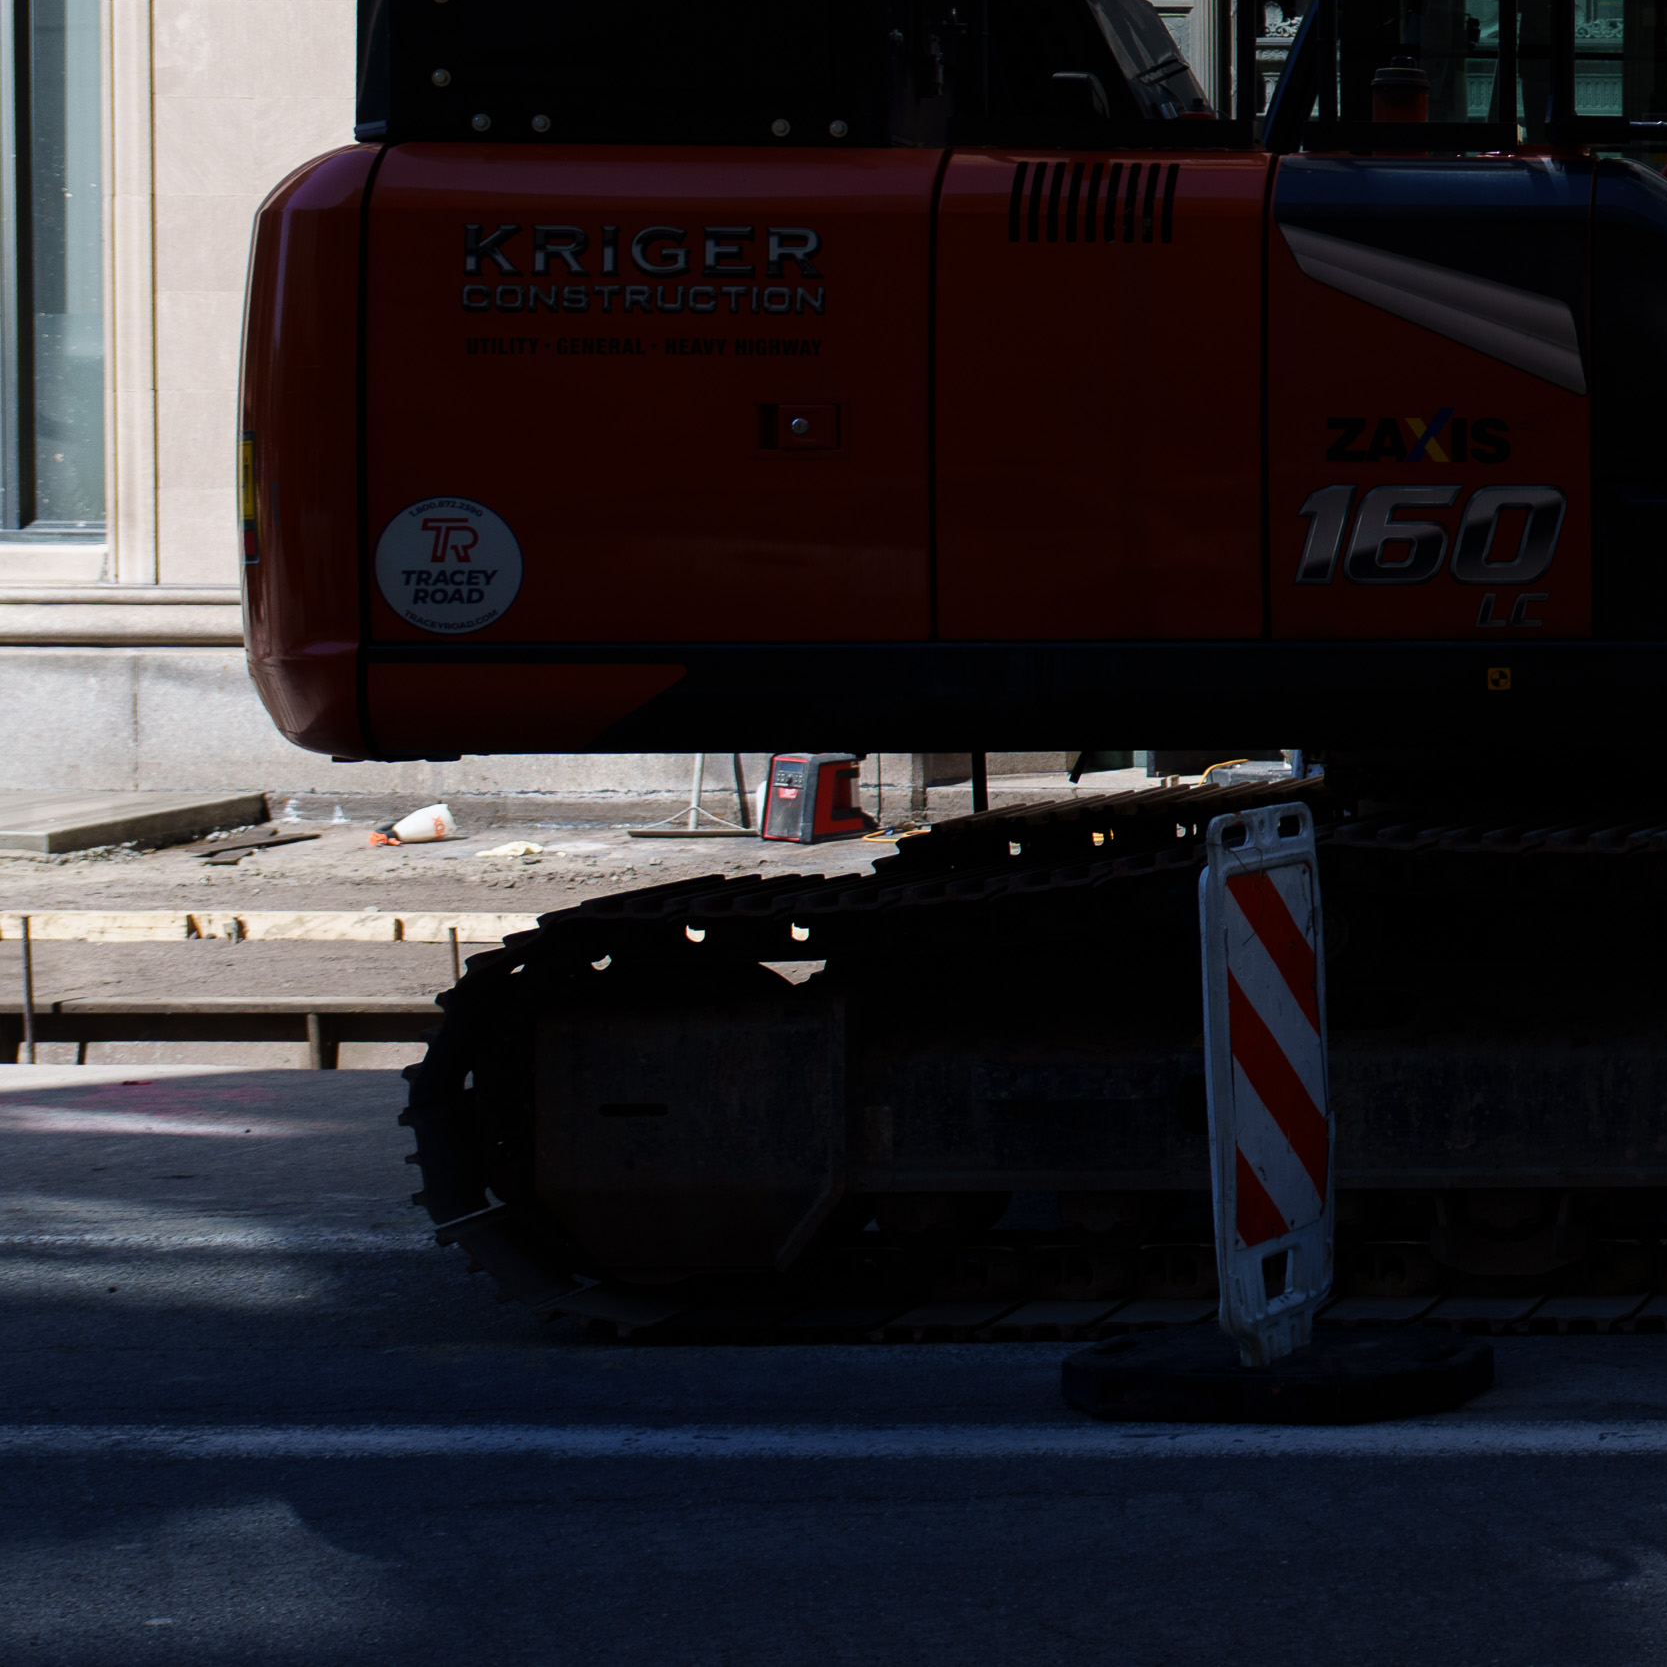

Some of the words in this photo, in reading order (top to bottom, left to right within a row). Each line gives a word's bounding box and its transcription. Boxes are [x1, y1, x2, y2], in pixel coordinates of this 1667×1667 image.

[462, 223, 824, 279] KRIGER
[461, 284, 826, 315] CONSTRUCTION
[466, 337, 539, 355] UTILITY
[557, 337, 646, 355] GENERAL
[665, 338, 726, 355] HEAVY
[735, 338, 822, 356] HIGHWAY
[1326, 407, 1511, 463] ZAXIS
[421, 518, 479, 563] TR
[1294, 484, 1567, 586] 160
[402, 569, 498, 586] TRACEY
[413, 588, 484, 604] ROAD
[1475, 592, 1550, 628] LC
[404, 609, 498, 631] TRACEYROAD.COM
